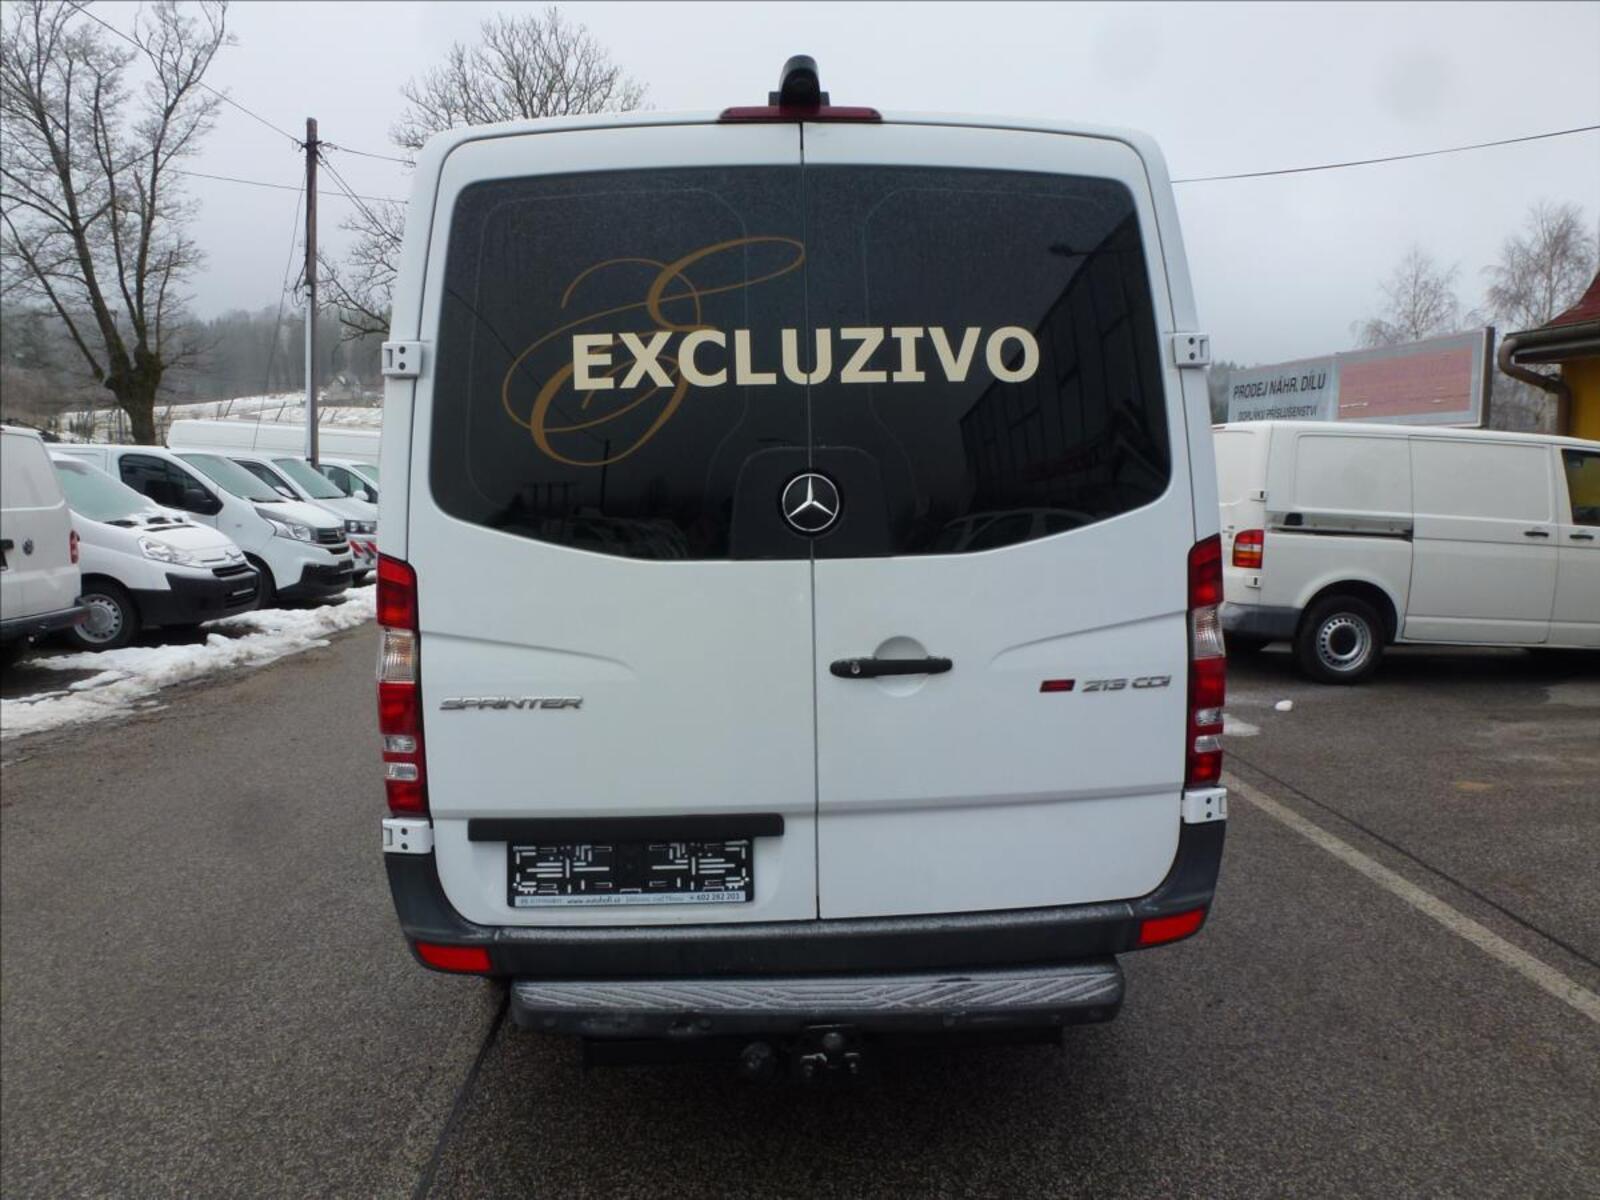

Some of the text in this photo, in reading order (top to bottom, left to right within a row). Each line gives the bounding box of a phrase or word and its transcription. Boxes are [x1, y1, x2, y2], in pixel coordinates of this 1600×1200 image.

[572, 325, 1040, 391] EXCLUZIVO
[1233, 381, 1268, 399] PRODEJ
[1082, 675, 1172, 692] 213 CDI
[440, 696, 583, 710] SPRINTER
